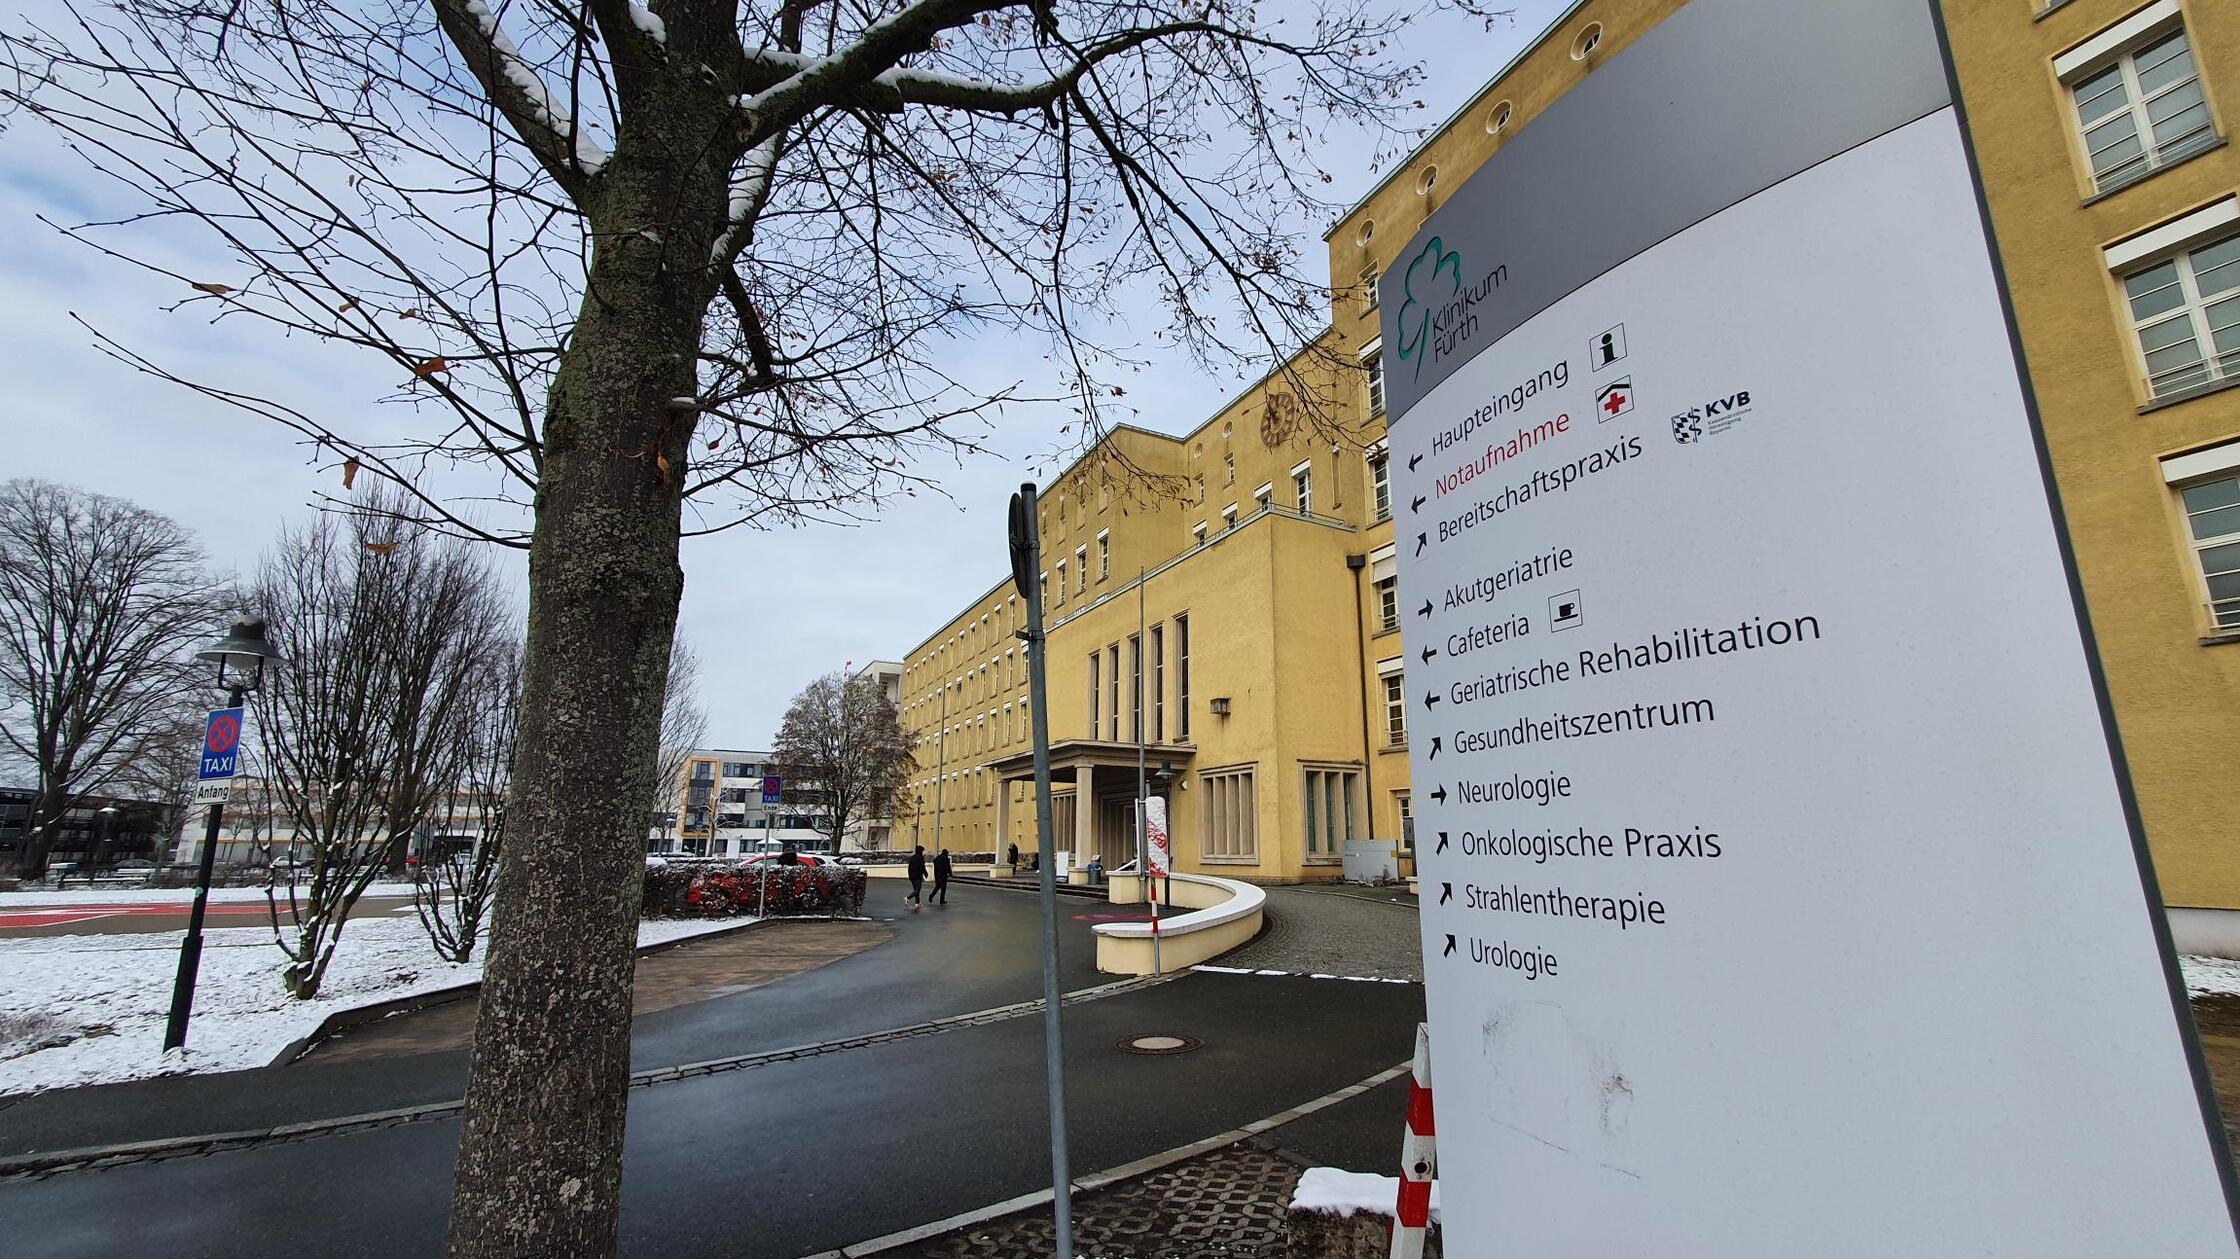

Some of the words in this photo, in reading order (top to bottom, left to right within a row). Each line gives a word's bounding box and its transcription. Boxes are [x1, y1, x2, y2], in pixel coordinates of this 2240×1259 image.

[1432, 263, 1508, 334] Klinikum
[1434, 311, 1480, 364] Fürth
[1432, 359, 1569, 457] Haupteingang
[1705, 390, 1751, 418] KVB
[1435, 412, 1570, 500] Notaufnahme
[1438, 434, 1643, 544] Bereitschaftspraxis
[1443, 546, 1573, 613] Akutgeriatrie
[1447, 613, 1530, 658] Cafeteria
[1450, 658, 1570, 705] Geriatrische
[1579, 615, 1821, 678] Rehabilitation
[1454, 698, 1715, 754] Gesundheitszentrum
[204, 756, 233, 773] TAXI
[1457, 771, 1572, 807] Neurologie
[197, 786, 229, 802] Anfang
[1461, 827, 1614, 865] Onkologische
[1624, 825, 1722, 858] Praxis
[1465, 883, 1666, 931] Strahlentherapie
[1469, 937, 1558, 983] Urologie
